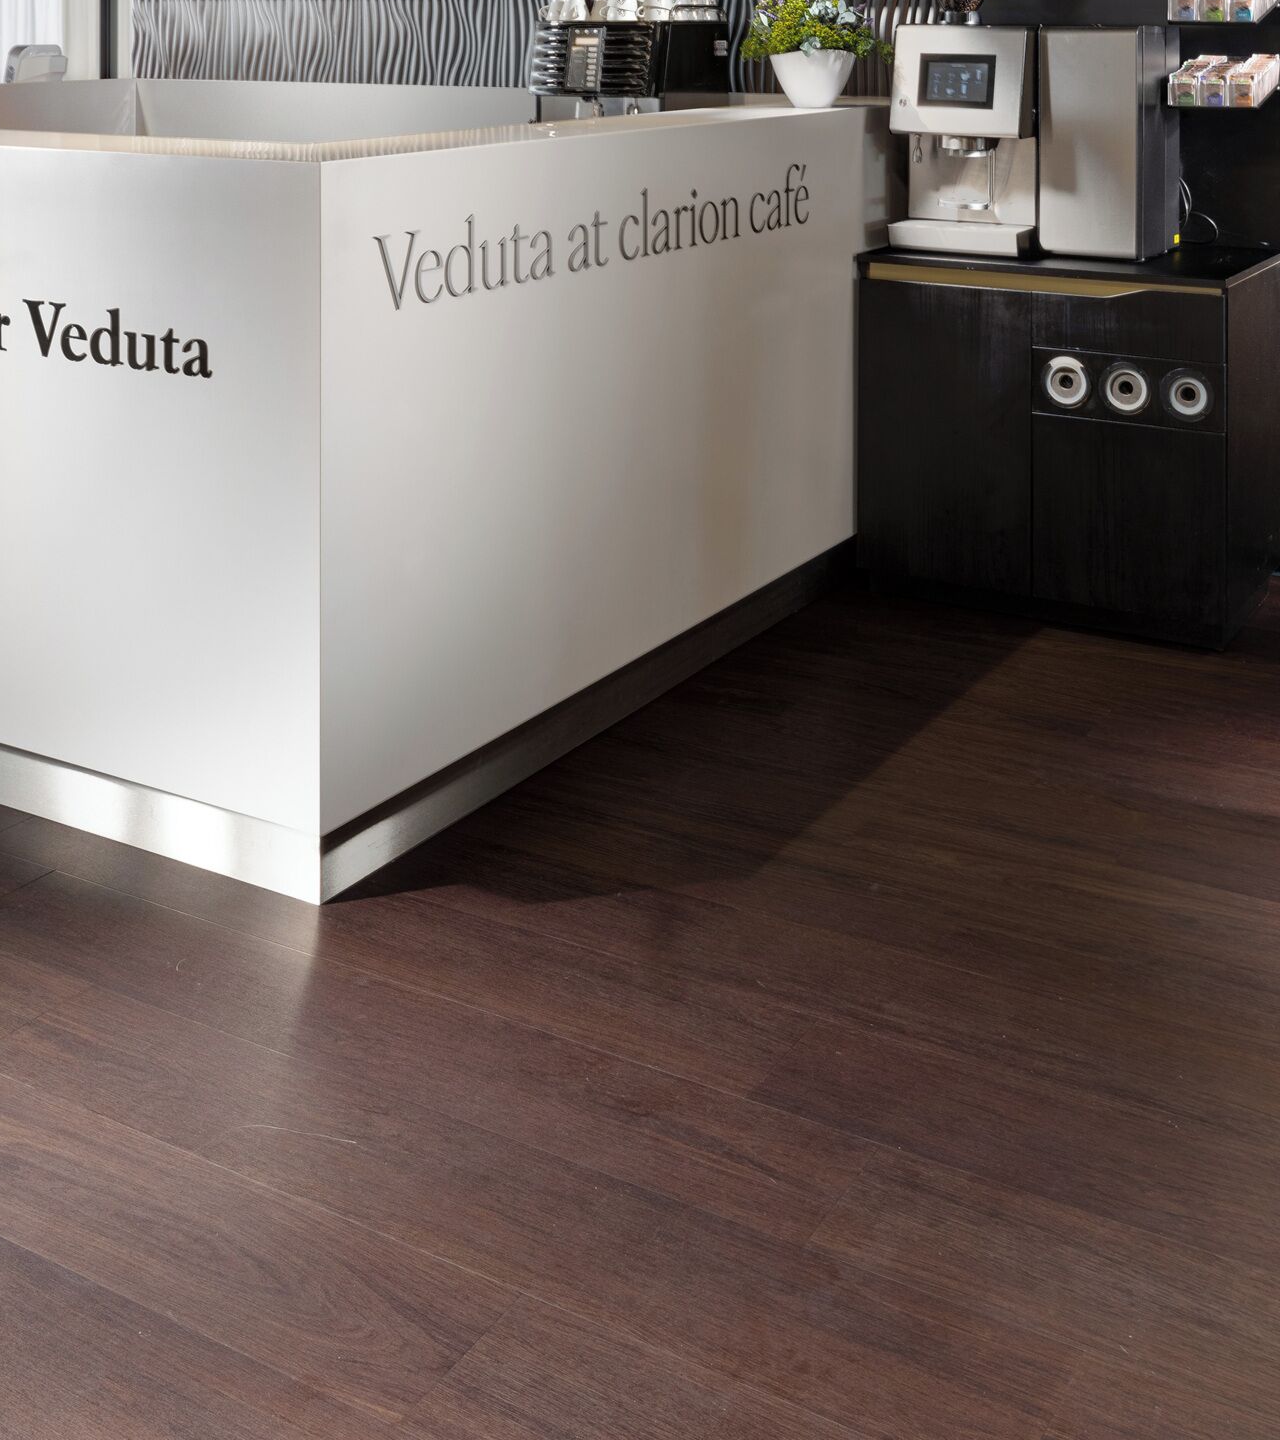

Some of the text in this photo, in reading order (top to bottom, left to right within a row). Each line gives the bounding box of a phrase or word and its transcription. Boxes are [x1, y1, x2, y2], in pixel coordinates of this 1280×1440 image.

[373, 163, 810, 311] Veduta at clarion café
[22, 298, 214, 379] Veduta
